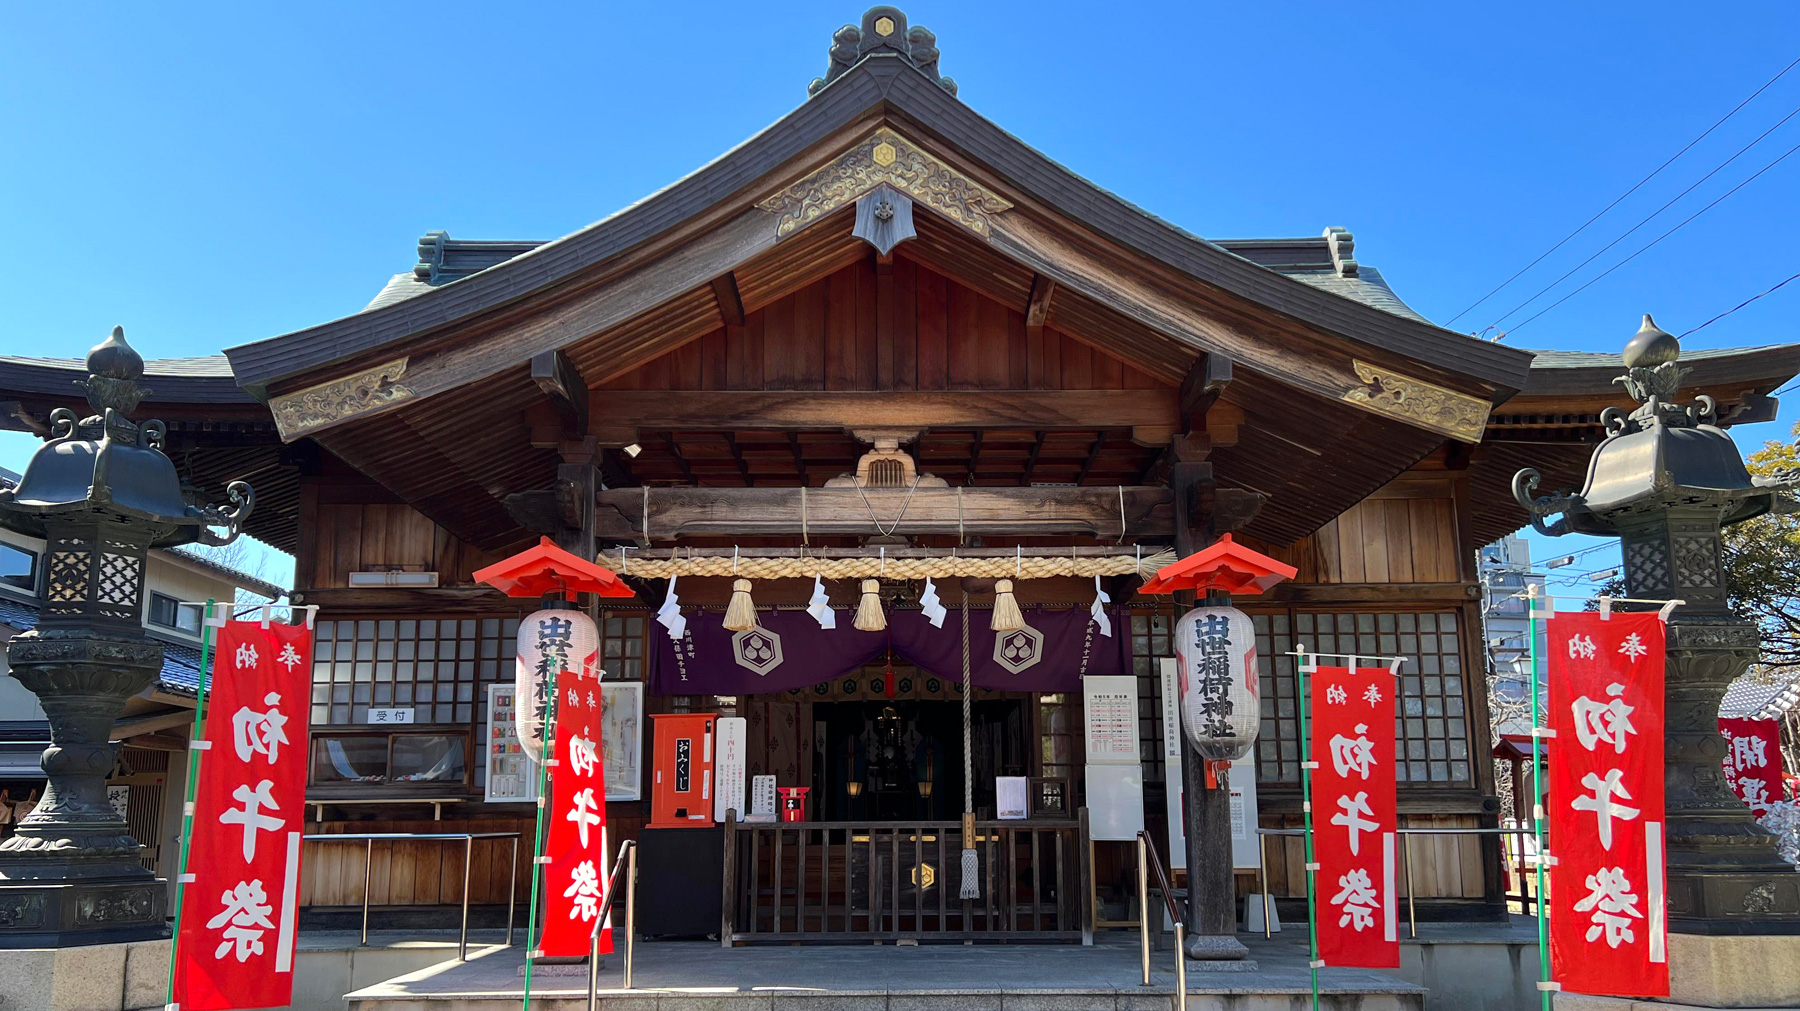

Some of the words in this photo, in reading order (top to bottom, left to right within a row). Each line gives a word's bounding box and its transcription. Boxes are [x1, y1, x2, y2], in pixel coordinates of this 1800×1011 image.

[1195, 614, 1237, 739] 出世稲荷神社
[376, 710, 406, 722] 受付
[677, 741, 690, 790] おみくじ
